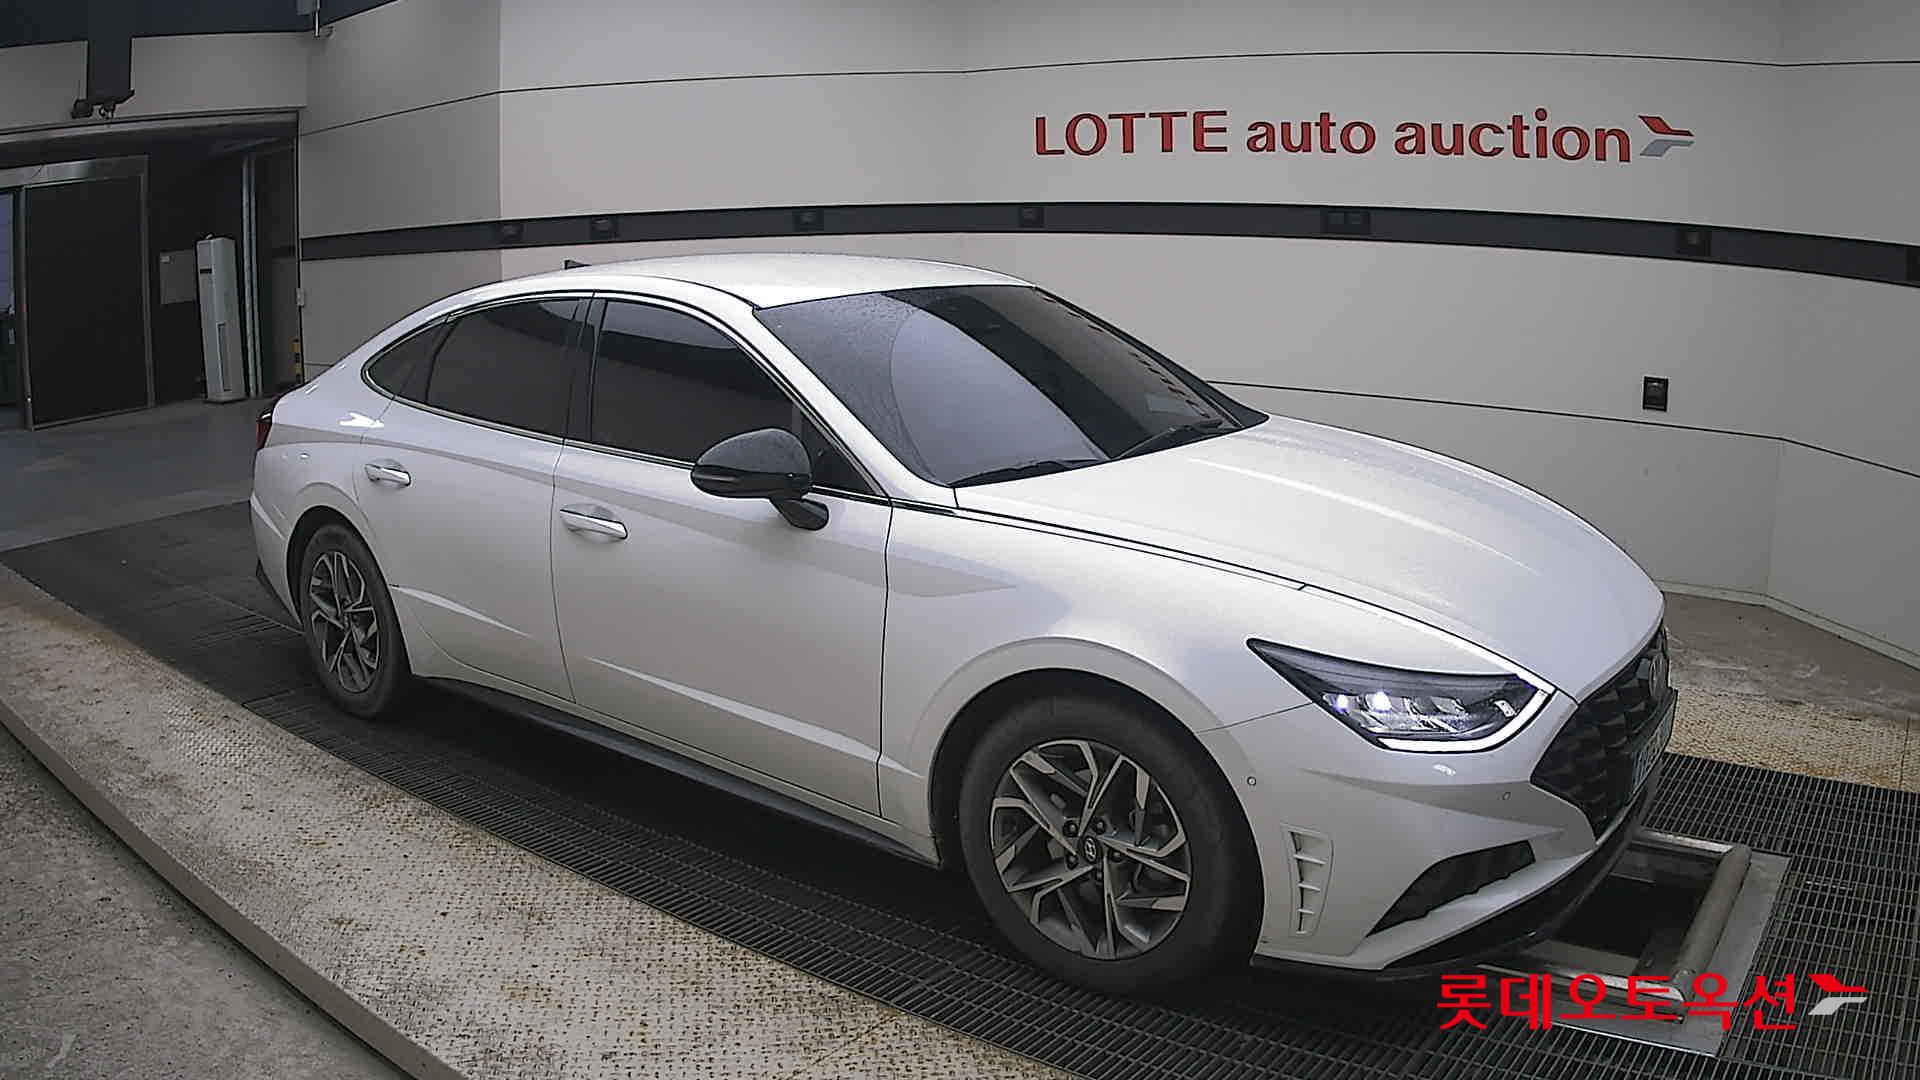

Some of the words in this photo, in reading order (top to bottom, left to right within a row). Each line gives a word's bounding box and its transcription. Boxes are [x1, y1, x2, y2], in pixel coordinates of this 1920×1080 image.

[1034, 110, 1228, 156] LOTTE
[1246, 111, 1377, 155] auto
[1394, 107, 1632, 163] auction
